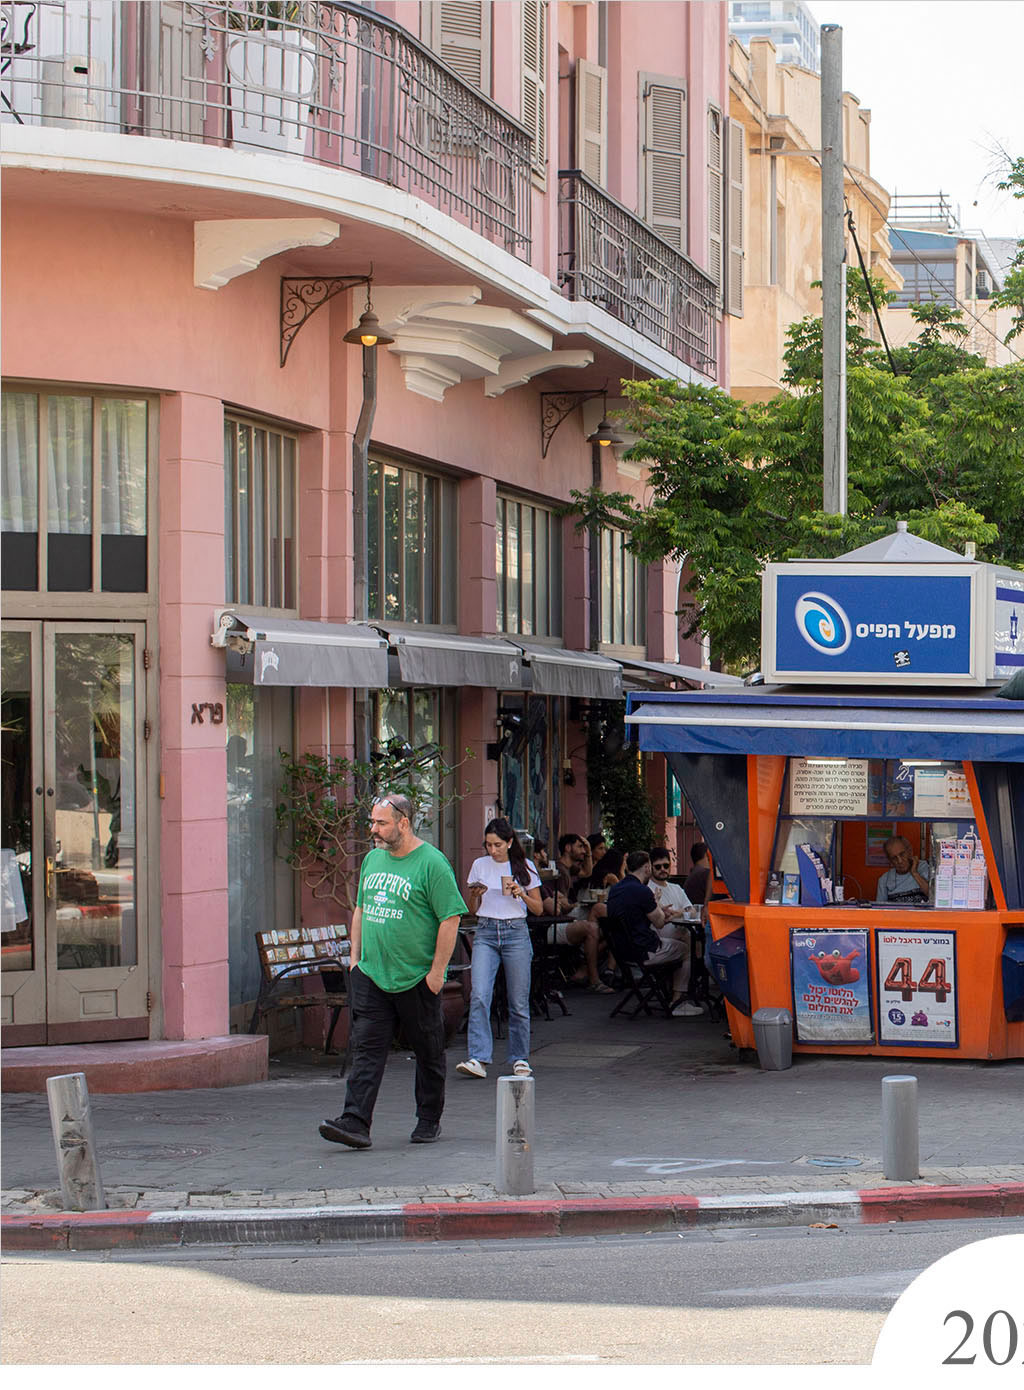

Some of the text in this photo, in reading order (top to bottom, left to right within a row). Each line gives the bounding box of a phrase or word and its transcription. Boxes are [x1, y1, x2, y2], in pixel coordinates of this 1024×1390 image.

[855, 620, 956, 641] מפעל הפיס
[899, 936, 922, 944] בדאבל
[884, 957, 952, 1003] 44
[808, 984, 854, 998] הלוטו יכול
[803, 992, 859, 1008] להגשים לכם
[808, 1003, 854, 1016] את החלום
